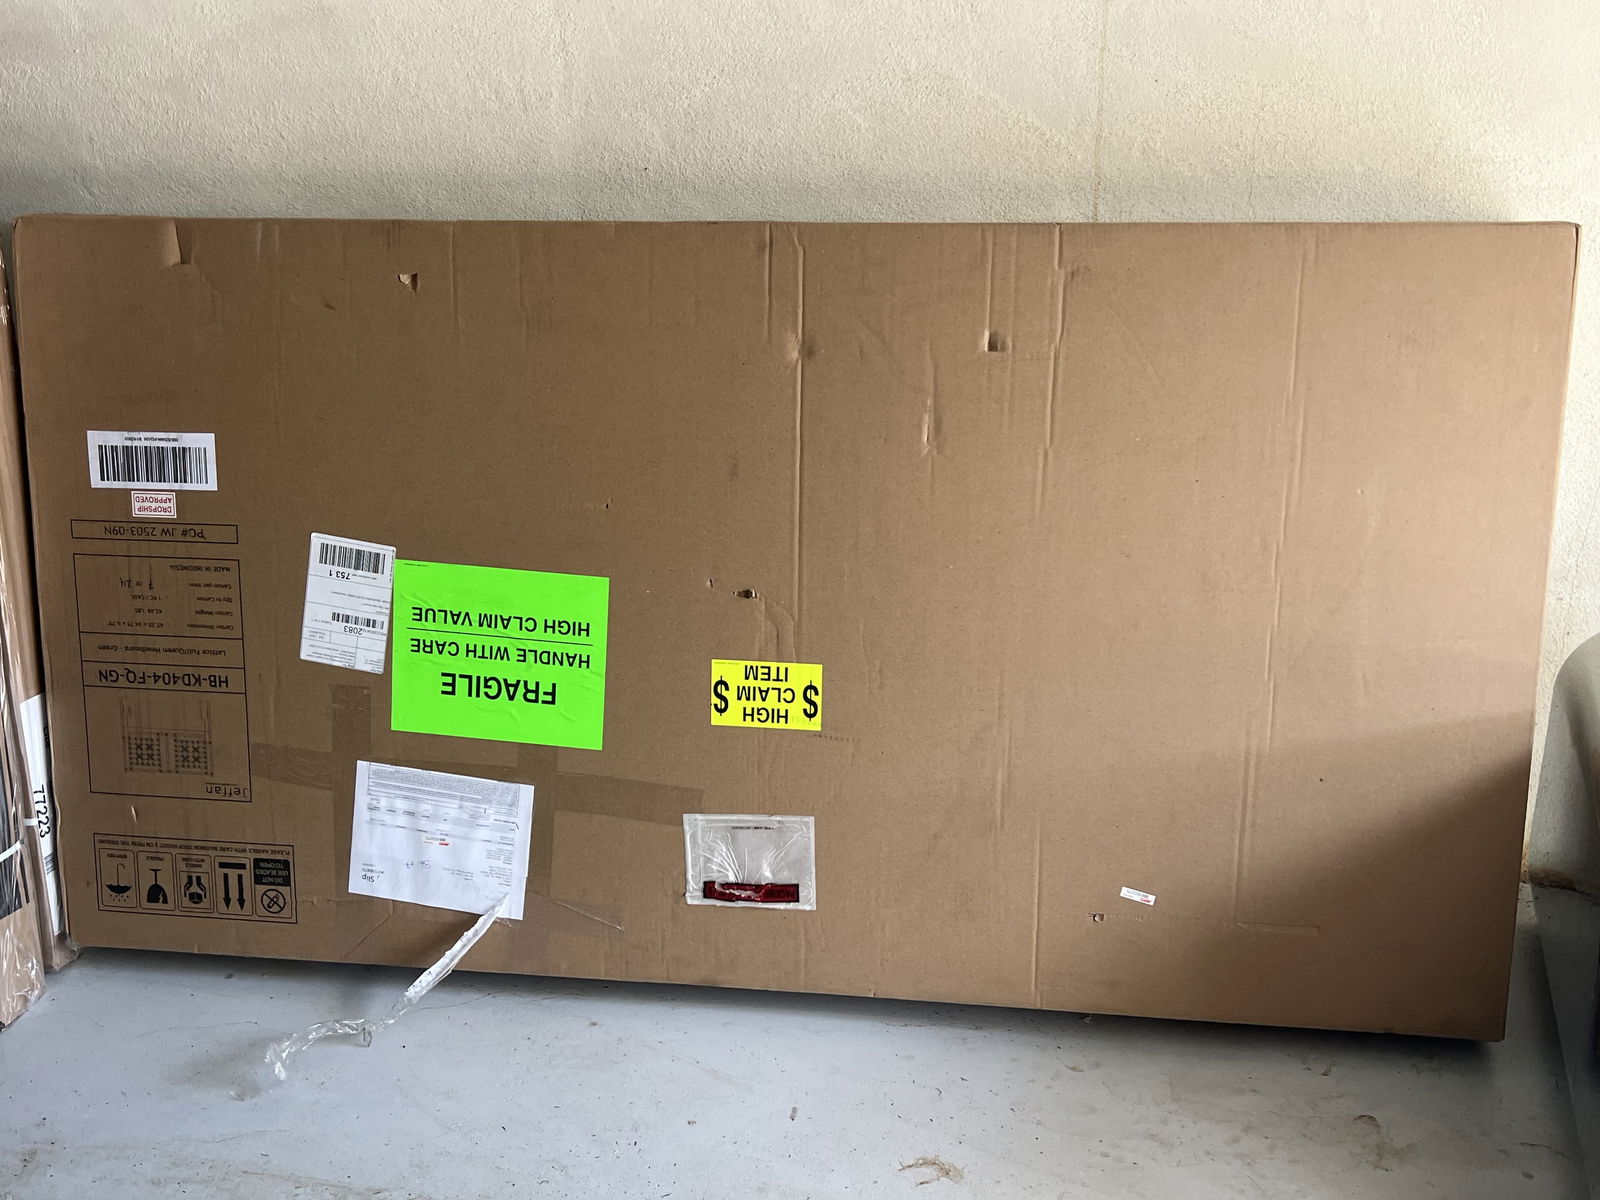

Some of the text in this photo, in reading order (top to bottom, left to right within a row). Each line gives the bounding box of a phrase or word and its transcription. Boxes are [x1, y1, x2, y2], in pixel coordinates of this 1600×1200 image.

[135, 496, 172, 504] APPROVED
[137, 505, 171, 513] DROPSHIP
[104, 526, 156, 537] 2503-09N
[159, 528, 176, 538] JW
[336, 571, 350, 579] 753
[411, 607, 590, 637] HIGH CLAIM VALUE
[124, 646, 160, 654] Headboard
[162, 647, 200, 656] Full/Queen
[410, 638, 590, 669] HANDLE WITH CARE
[98, 668, 229, 688] HB-KD404-FQ-GN
[745, 665, 788, 682] ITEM
[441, 672, 556, 705] FRAGILE
[737, 686, 795, 703] CLAIM
[743, 707, 788, 724] HIGH
[33, 784, 50, 839] 77223
[361, 873, 374, 883] Slip
